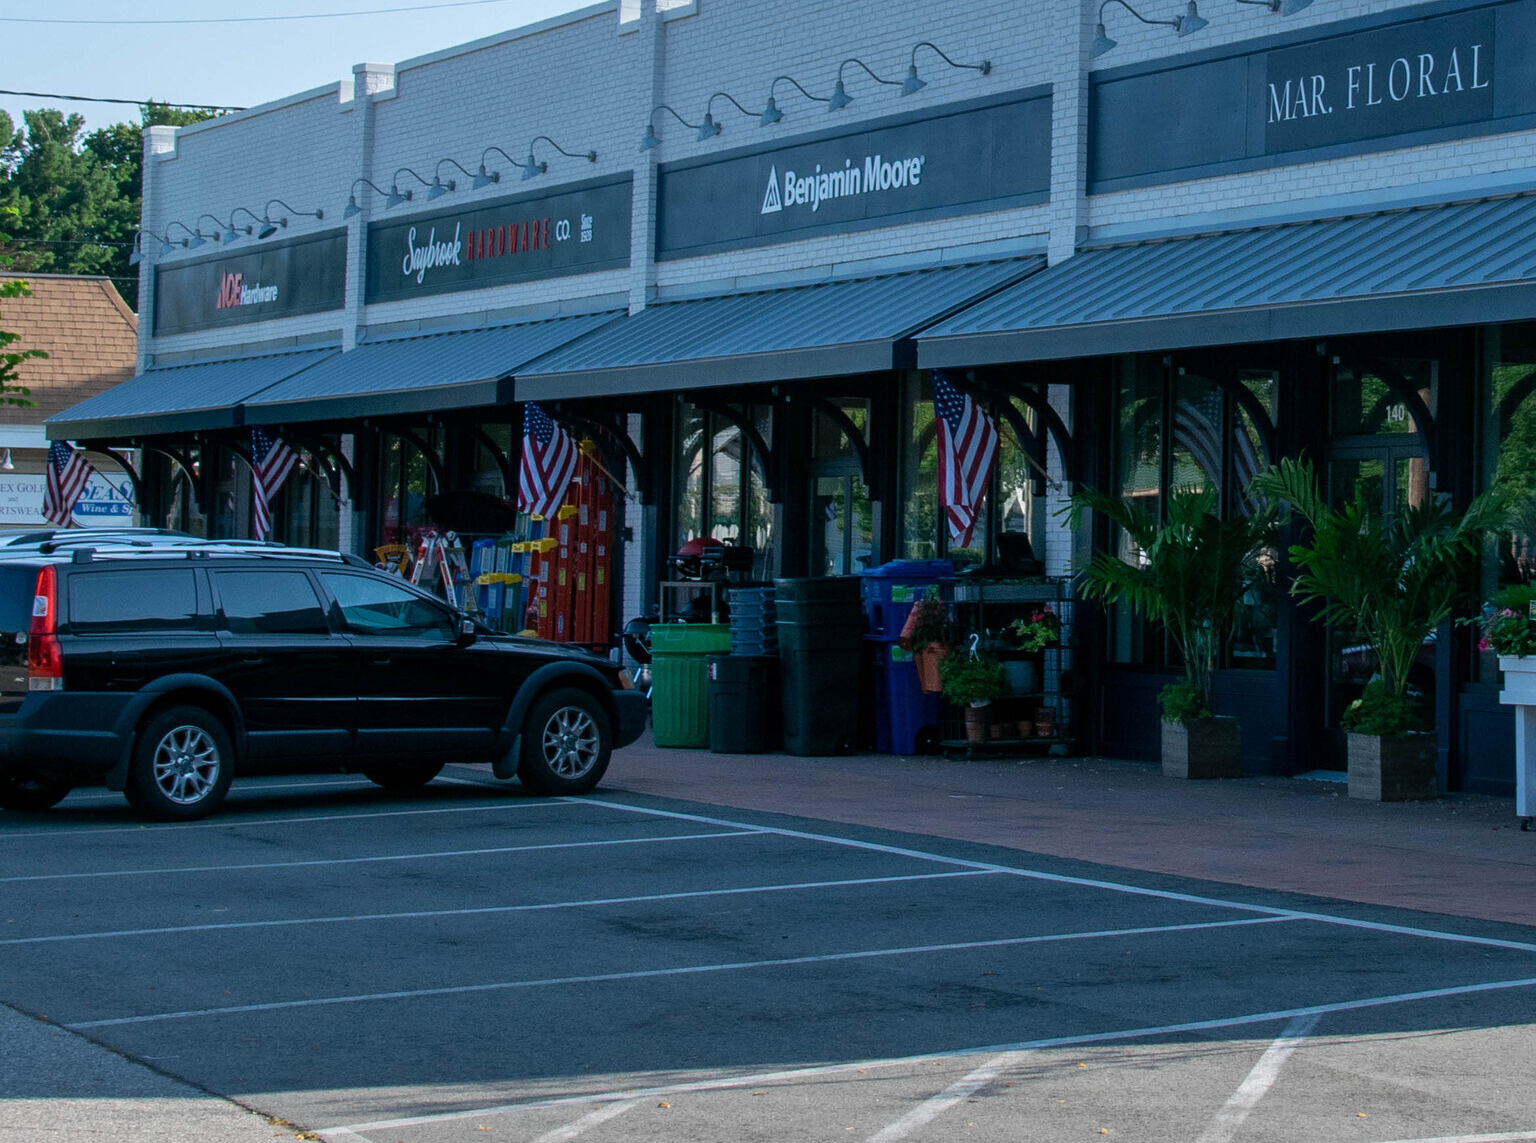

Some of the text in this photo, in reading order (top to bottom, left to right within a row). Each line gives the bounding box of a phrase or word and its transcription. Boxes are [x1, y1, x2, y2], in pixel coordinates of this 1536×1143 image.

[1268, 44, 1490, 124] MAR. FLORAL
[784, 158, 861, 212] Benjamin
[403, 221, 462, 284] Saybrook
[466, 218, 551, 261] HARDWARE
[216, 269, 278, 309] ACE Hardware
[1386, 404, 1405, 423] 140
[81, 503, 107, 513] Wine
